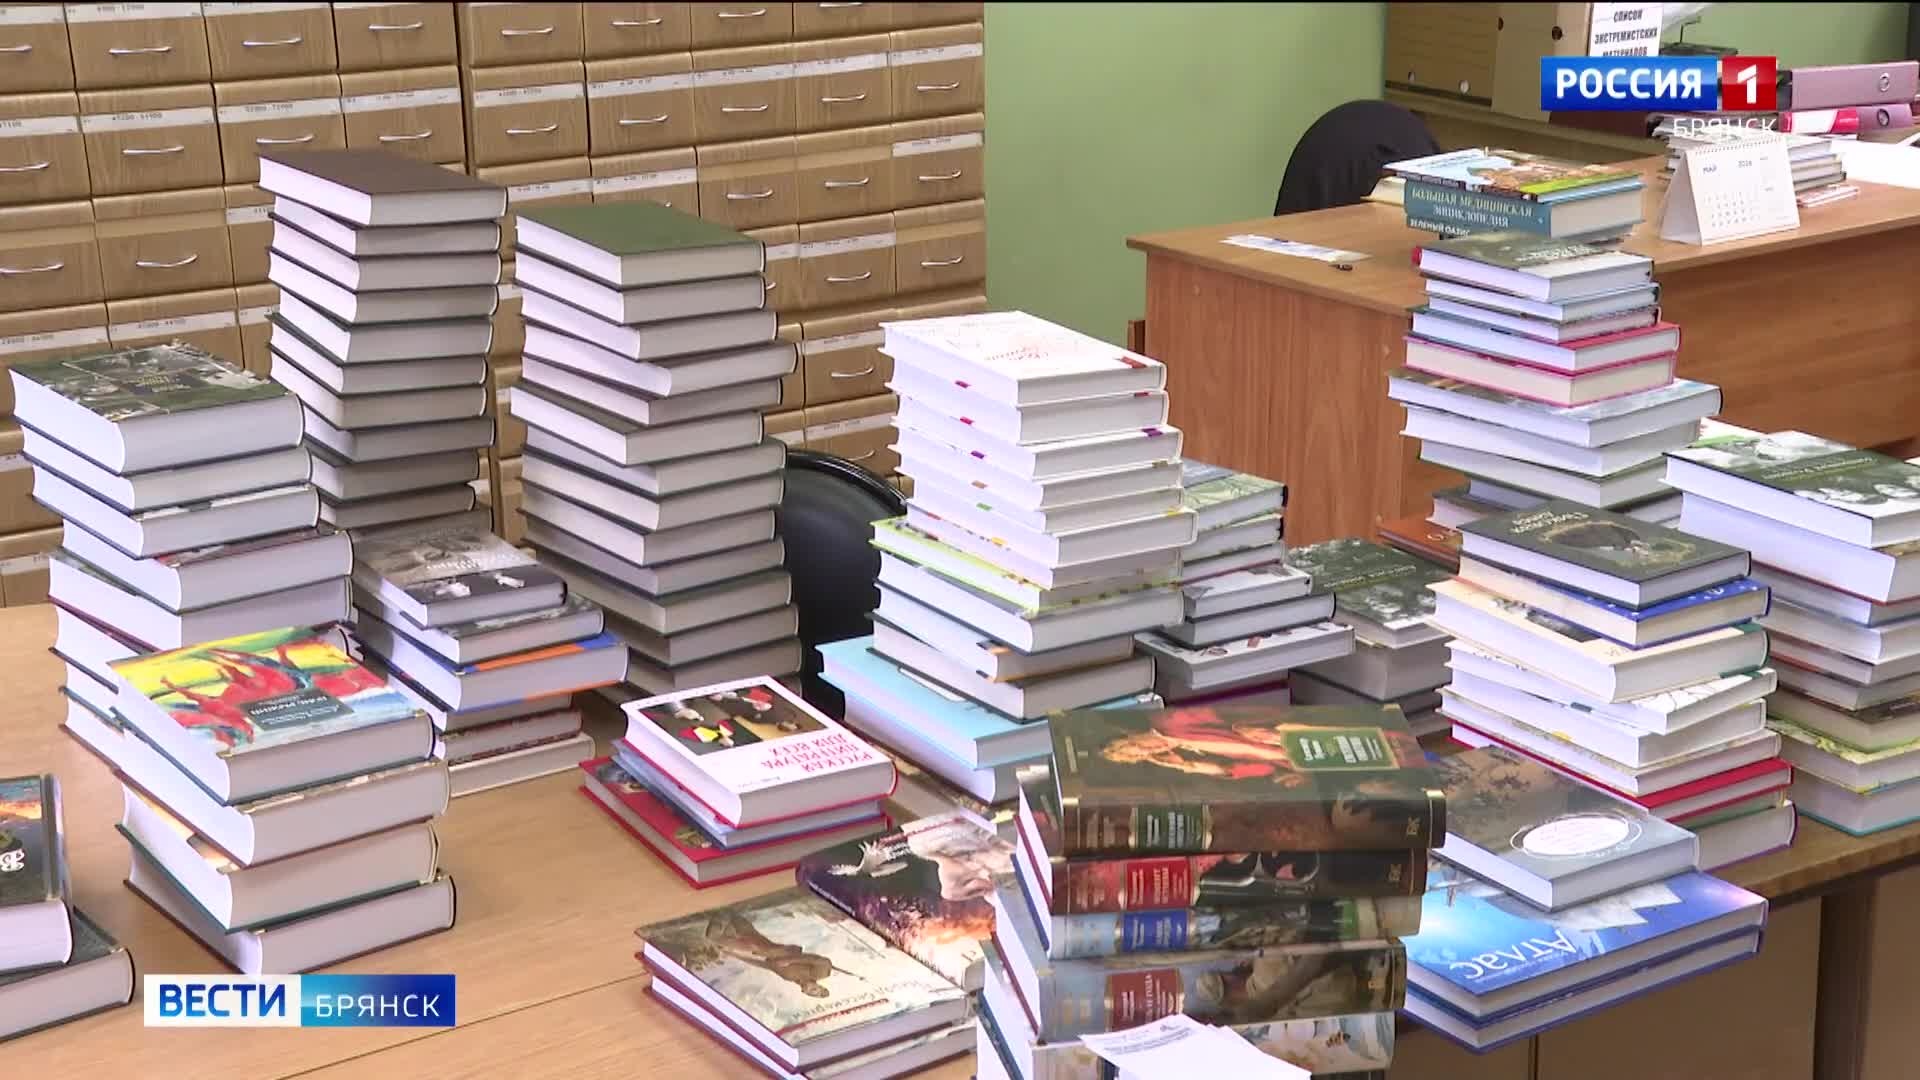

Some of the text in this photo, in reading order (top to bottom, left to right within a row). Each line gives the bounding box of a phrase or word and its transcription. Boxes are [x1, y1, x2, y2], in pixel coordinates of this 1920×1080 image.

[1613, 9, 1643, 23] СПИСОК
[1594, 27, 1658, 45] ЭКСТРЕМИСТСКИХ
[1411, 187, 1534, 217] БОЛЬШАЯ МЕДИЦИНСКАЯ
[1432, 204, 1510, 228] ЭНЦИКЛОПЕДИЯ
